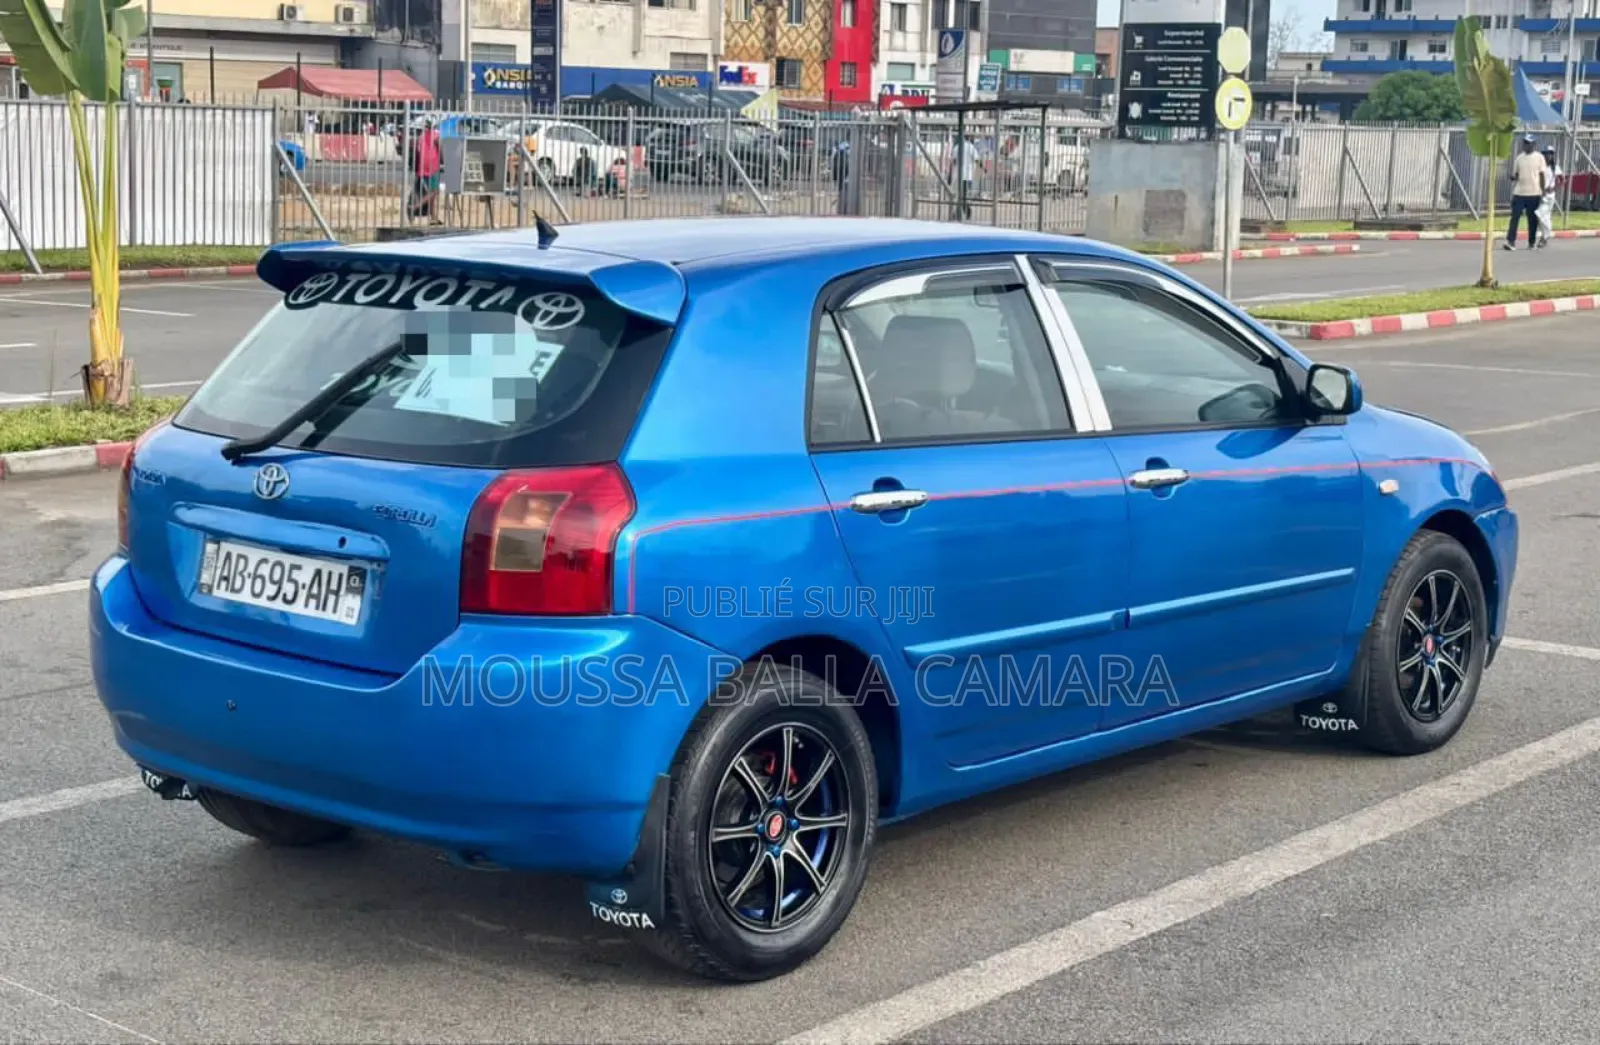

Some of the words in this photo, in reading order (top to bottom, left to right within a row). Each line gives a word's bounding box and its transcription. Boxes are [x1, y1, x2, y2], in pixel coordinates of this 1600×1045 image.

[332, 273, 516, 309] TOYOTA
[1300, 714, 1360, 731] TOYOTA
[589, 901, 656, 929] TOYOTA
